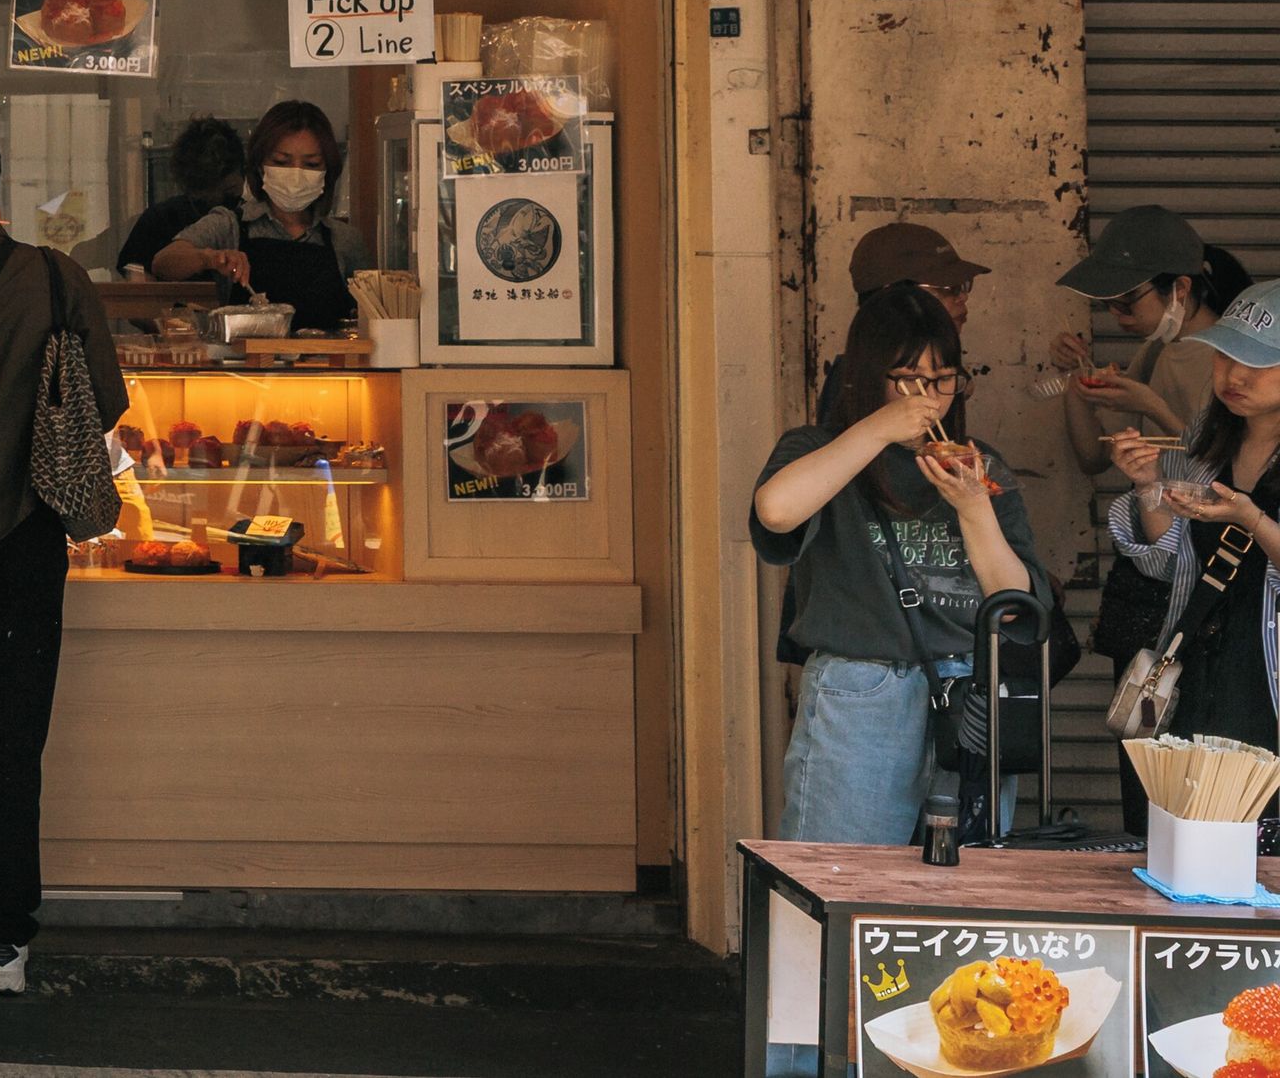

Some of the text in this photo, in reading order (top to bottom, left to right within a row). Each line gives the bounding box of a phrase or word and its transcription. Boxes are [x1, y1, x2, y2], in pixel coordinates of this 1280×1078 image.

[359, 25, 413, 54] Line
[85, 54, 141, 72] 3,000円
[518, 155, 574, 173] 3,000円
[453, 475, 500, 496] NEW!!
[867, 521, 950, 543] SHERE
[863, 926, 1097, 960] ウニイクラいなり
